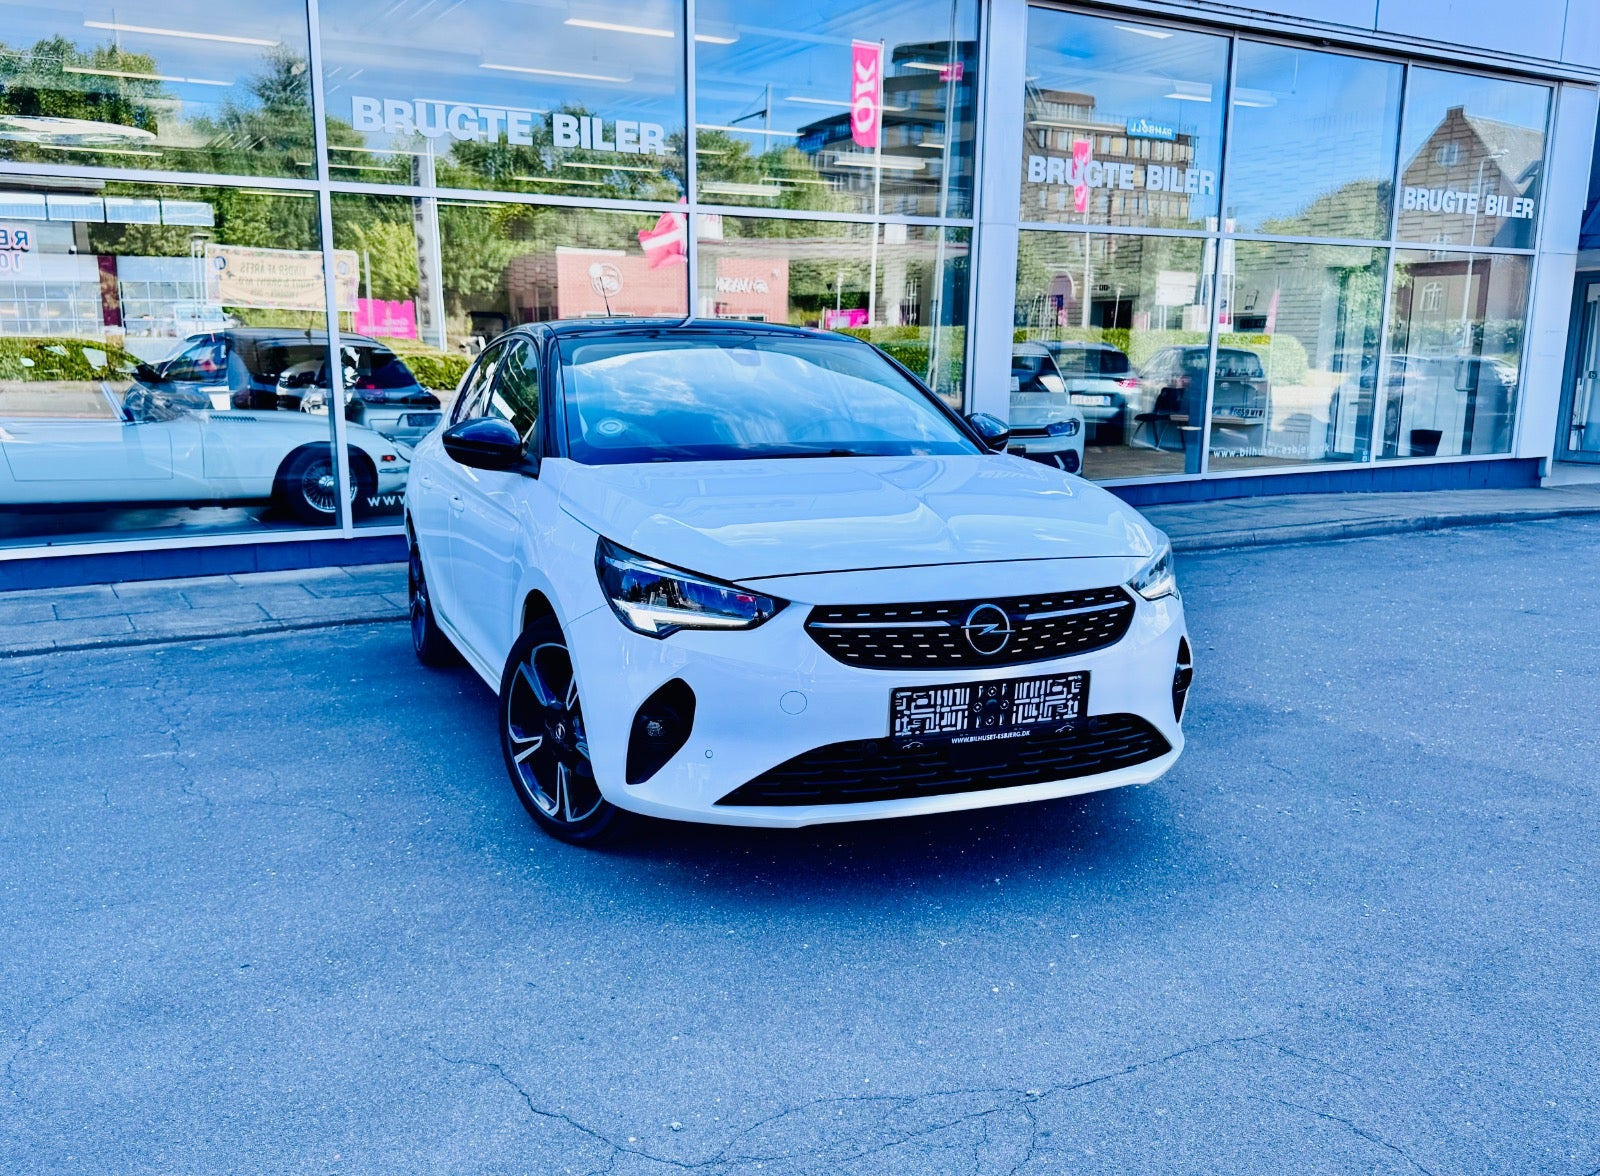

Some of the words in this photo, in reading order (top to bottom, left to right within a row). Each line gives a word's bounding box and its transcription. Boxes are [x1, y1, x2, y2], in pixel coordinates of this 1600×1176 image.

[351, 96, 533, 146] BRUGTE
[552, 113, 666, 155] BILER
[1027, 155, 1136, 190] BRUGTE
[1146, 164, 1216, 195] BILER
[1403, 186, 1479, 215] BRUGTE
[1485, 194, 1535, 219] BILER
[951, 730, 1031, 744] WWW.BILHUSET-ESBJERG.DK
